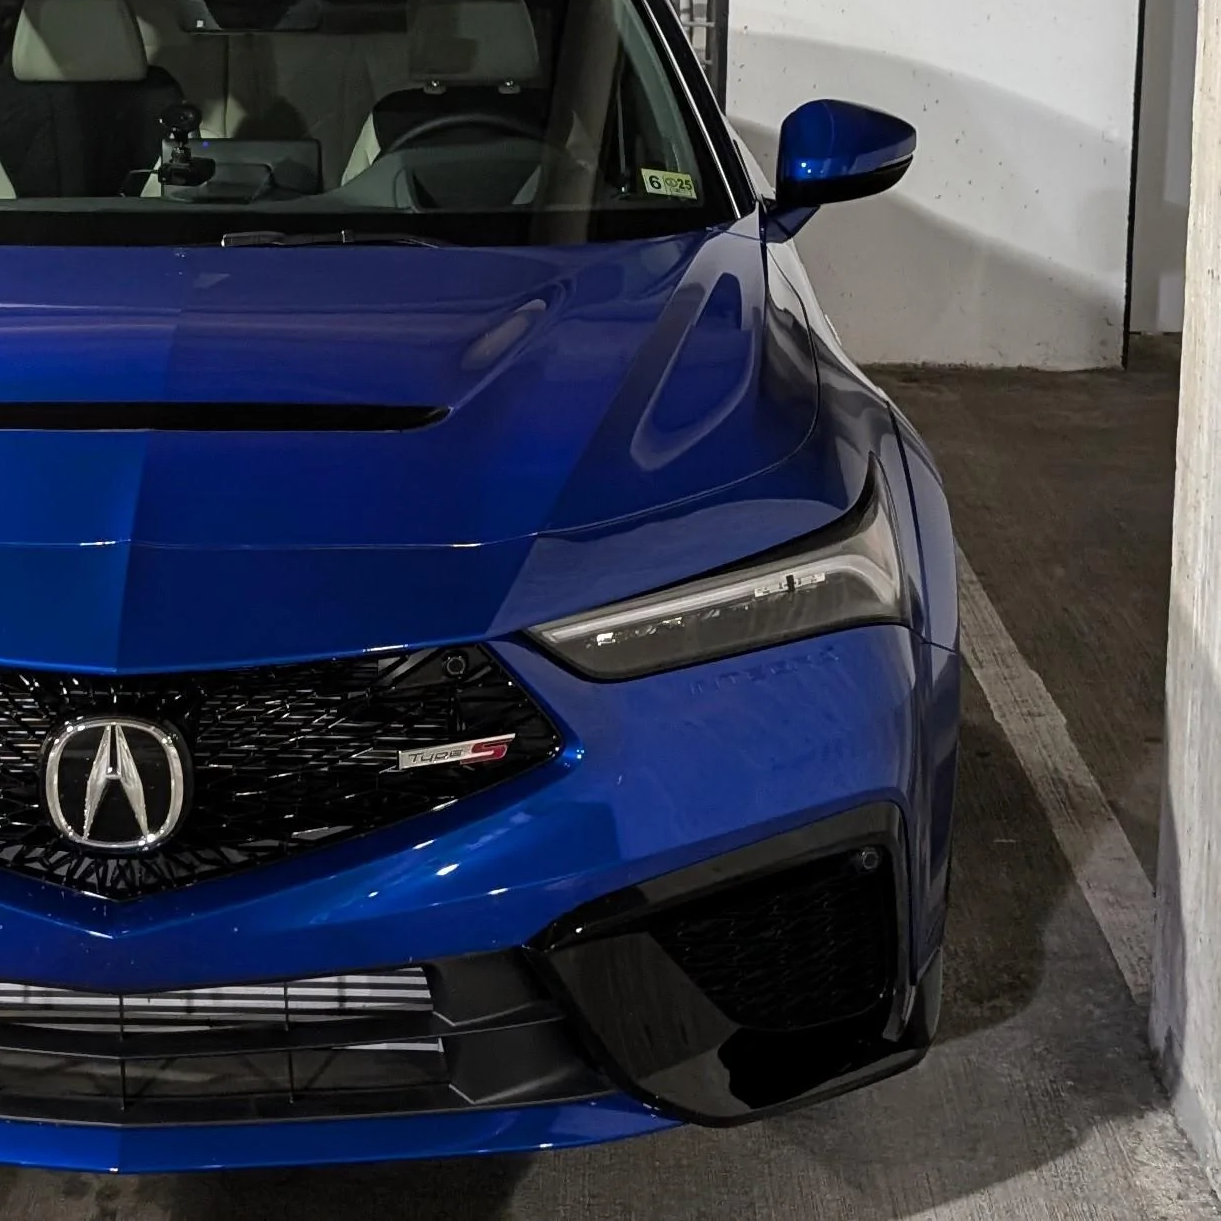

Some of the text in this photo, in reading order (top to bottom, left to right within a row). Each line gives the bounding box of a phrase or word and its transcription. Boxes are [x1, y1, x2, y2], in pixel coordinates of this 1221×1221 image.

[649, 175, 692, 190] 6 25
[460, 737, 515, 765] S
